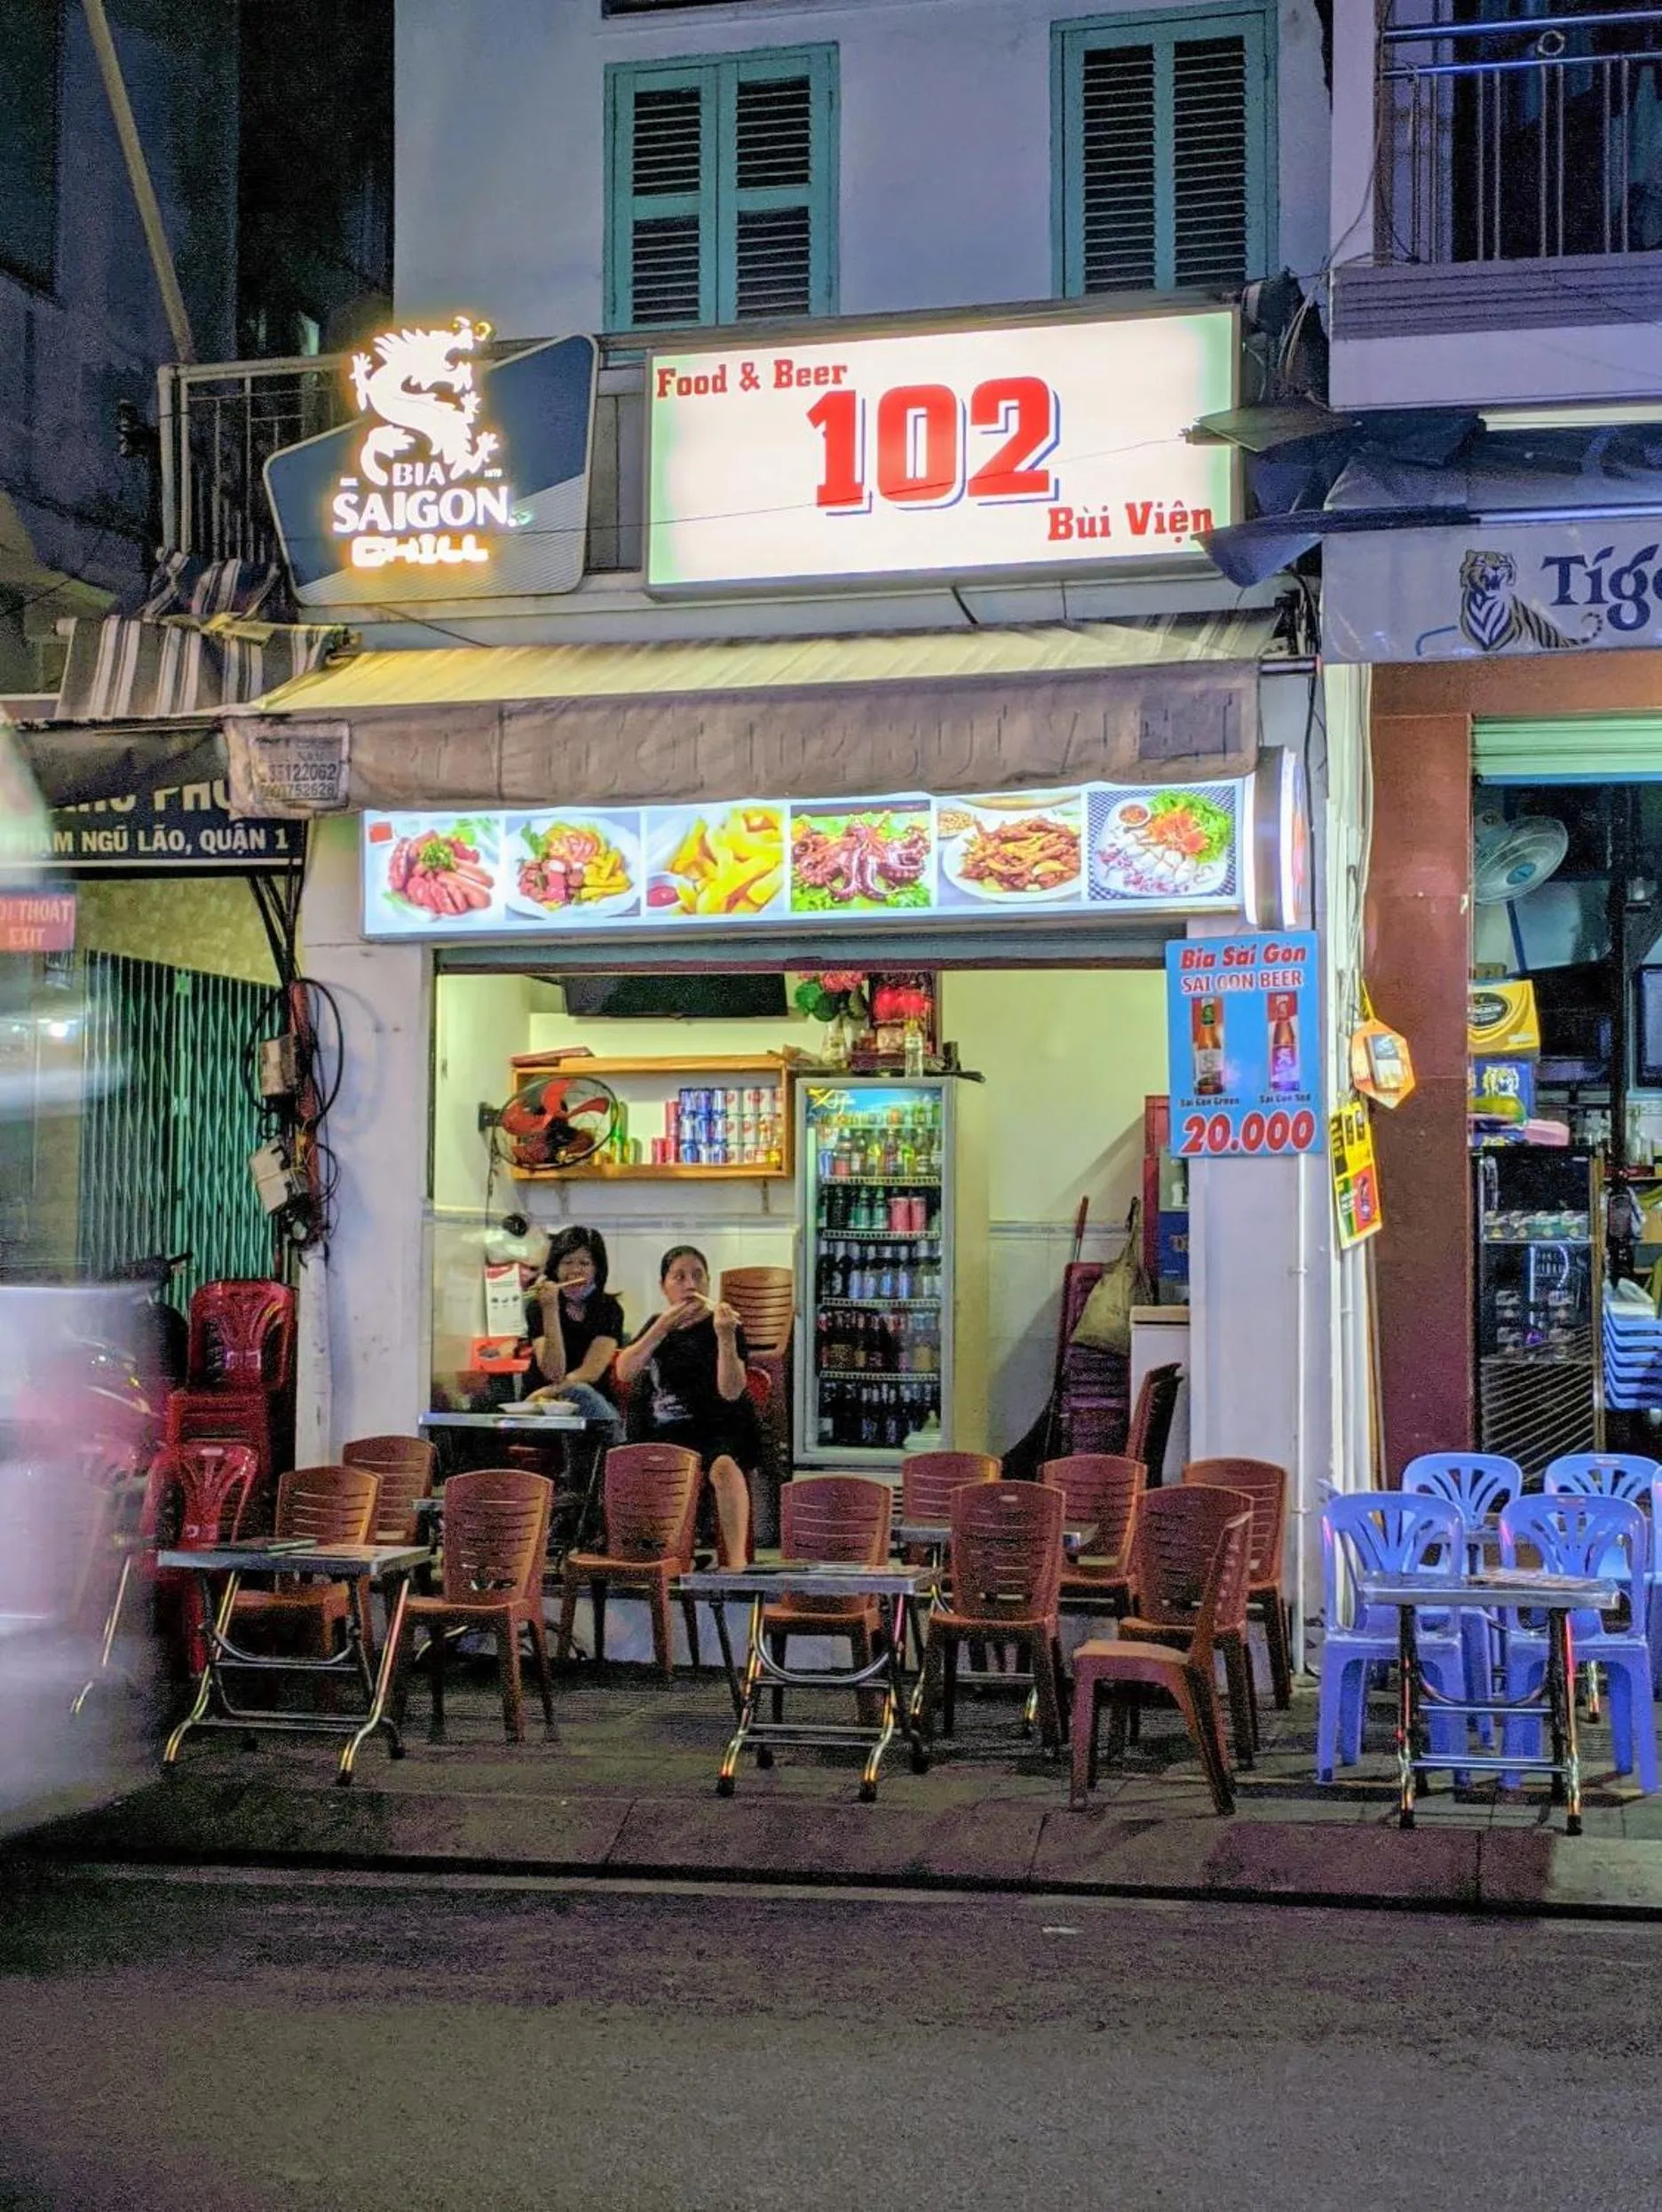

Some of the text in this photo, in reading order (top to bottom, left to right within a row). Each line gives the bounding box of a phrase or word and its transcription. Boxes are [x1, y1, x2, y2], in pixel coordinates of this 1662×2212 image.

[657, 359, 848, 398] Food & Beer
[806, 377, 1058, 513] 102
[392, 462, 445, 487] BIA
[1048, 500, 1215, 543] Bùi Viện
[1540, 543, 1662, 631] Tig
[82, 825, 129, 852] NGŨ
[138, 823, 193, 855] LÃO,
[200, 823, 265, 854] QUẬN
[275, 829, 289, 849] 1
[1181, 947, 1215, 970] Bia
[1183, 970, 1302, 994] SAI GON BEER
[1181, 1110, 1315, 1154] 20.000
